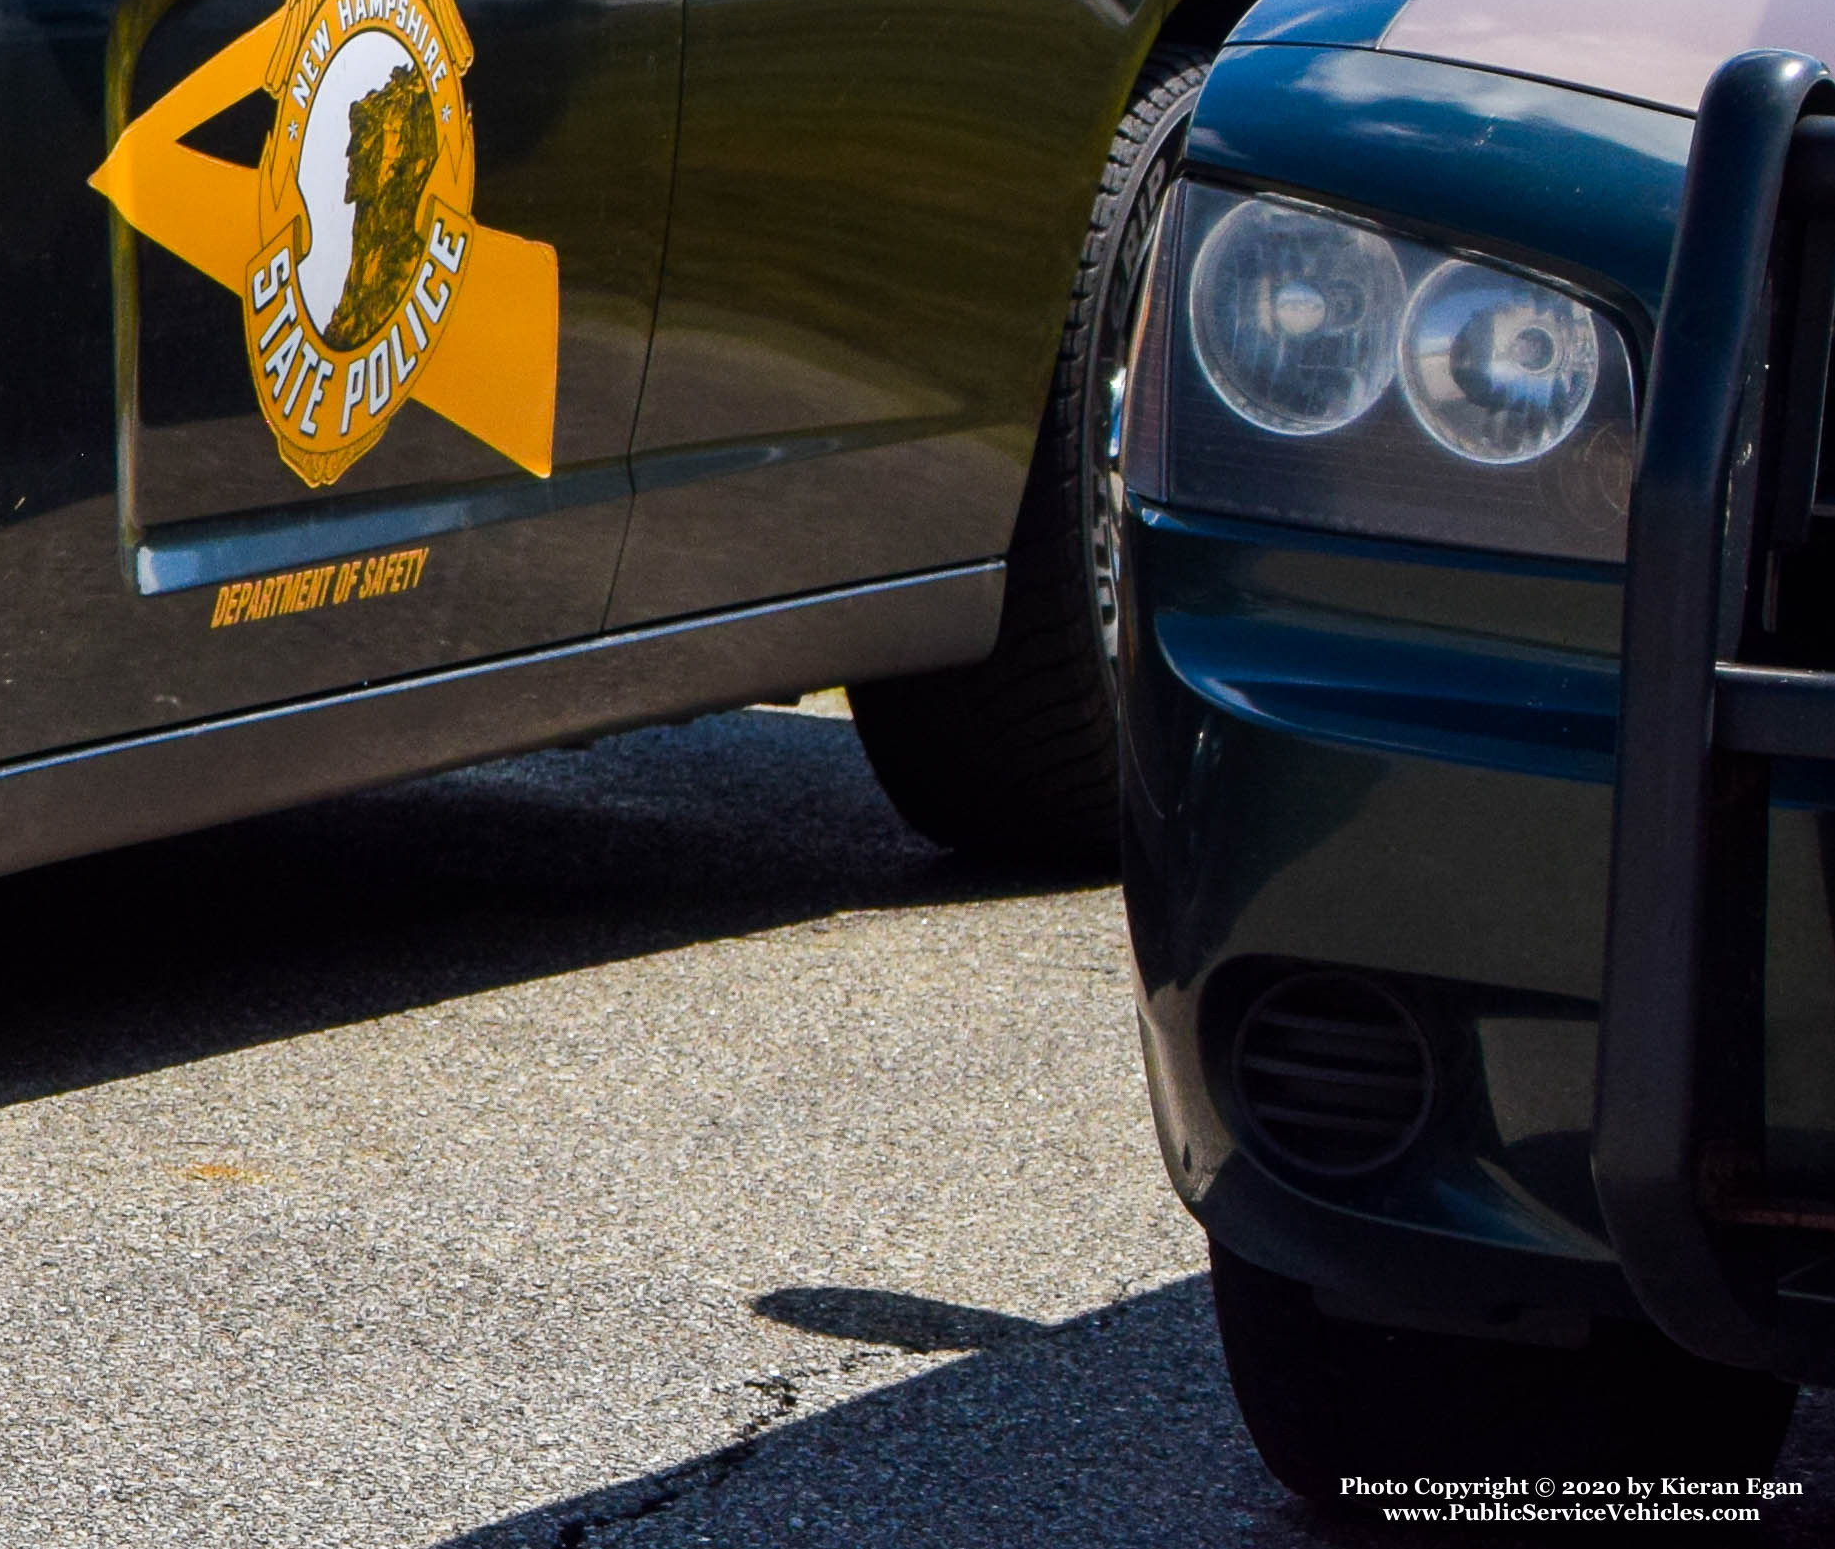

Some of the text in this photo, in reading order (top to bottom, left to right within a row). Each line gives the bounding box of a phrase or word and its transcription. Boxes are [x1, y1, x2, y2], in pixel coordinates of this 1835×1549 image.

[292, 20, 331, 109] NEW
[252, 220, 467, 436] STATE POLICE
[210, 547, 429, 628] DEPARTMENT OF SAFETY
